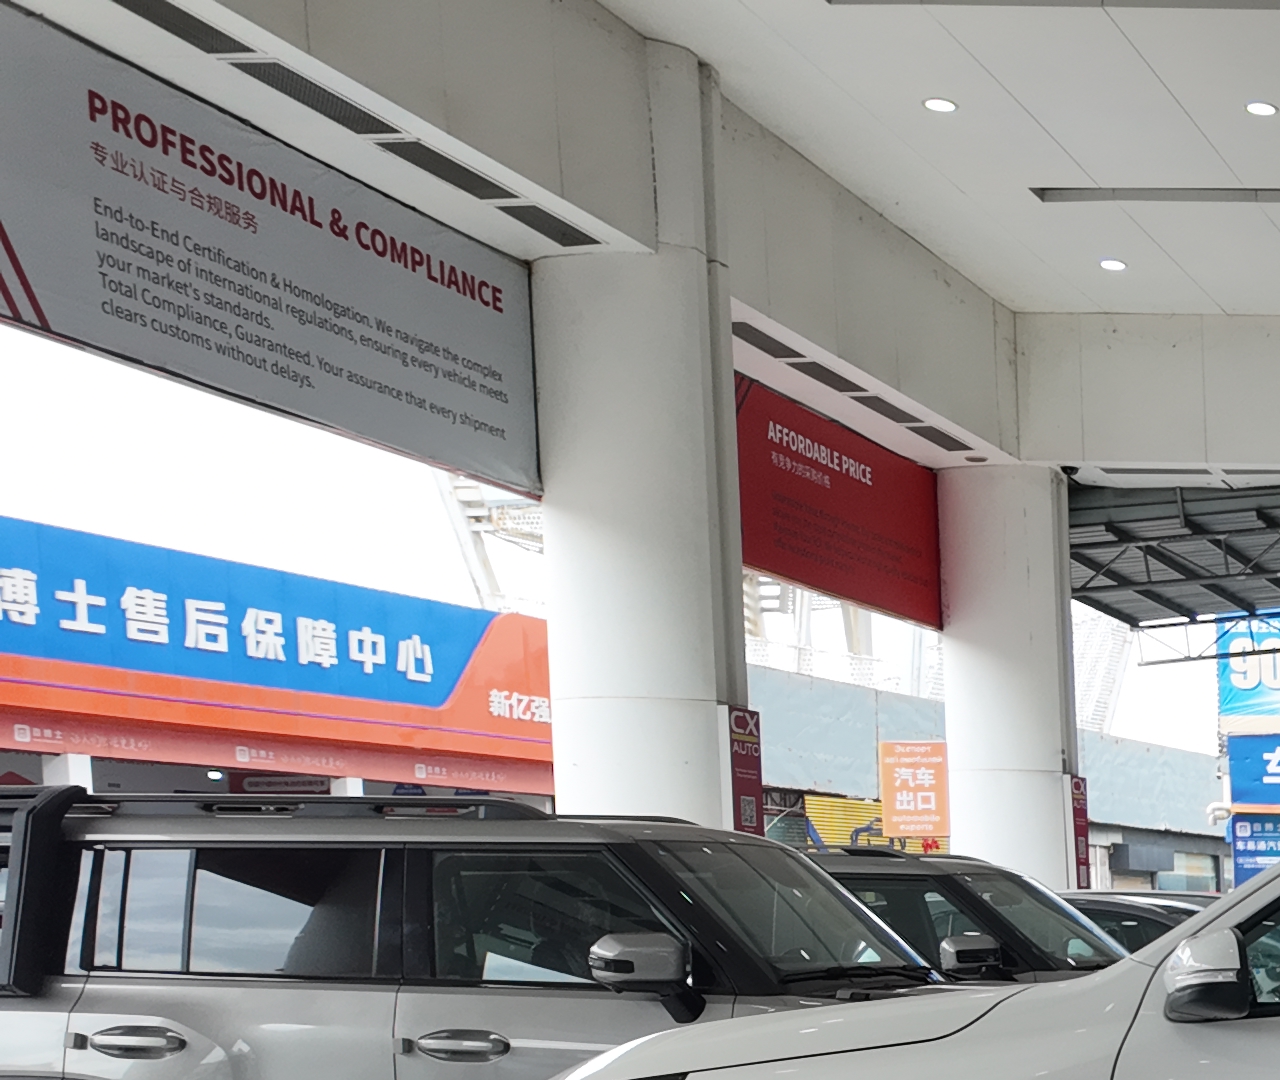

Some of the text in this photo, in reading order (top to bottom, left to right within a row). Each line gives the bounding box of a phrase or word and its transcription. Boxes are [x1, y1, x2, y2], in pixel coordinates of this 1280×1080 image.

[88, 89, 504, 314] PROFESSIONAL & COMPLIANCE
[89, 141, 259, 234] 专业认证与合规服务
[93, 197, 503, 383] End-to-End Certification & Homologation. We navigate the complex
[95, 220, 509, 404] landscape of international regulations, ensuring every vehicle meets
[96, 250, 275, 331] your market's standards.
[98, 271, 507, 441] Total Compliance, Guaranteed. Your assurance that every shipment
[101, 298, 315, 390] clears customs without delays.
[767, 420, 873, 486] AFFORDABLE PRICE
[0, 567, 434, 683] 博士售后保障中心
[730, 710, 759, 736] CX
[732, 741, 760, 757] AUTO
[893, 767, 936, 788] 汽车
[895, 790, 936, 811] 出口
